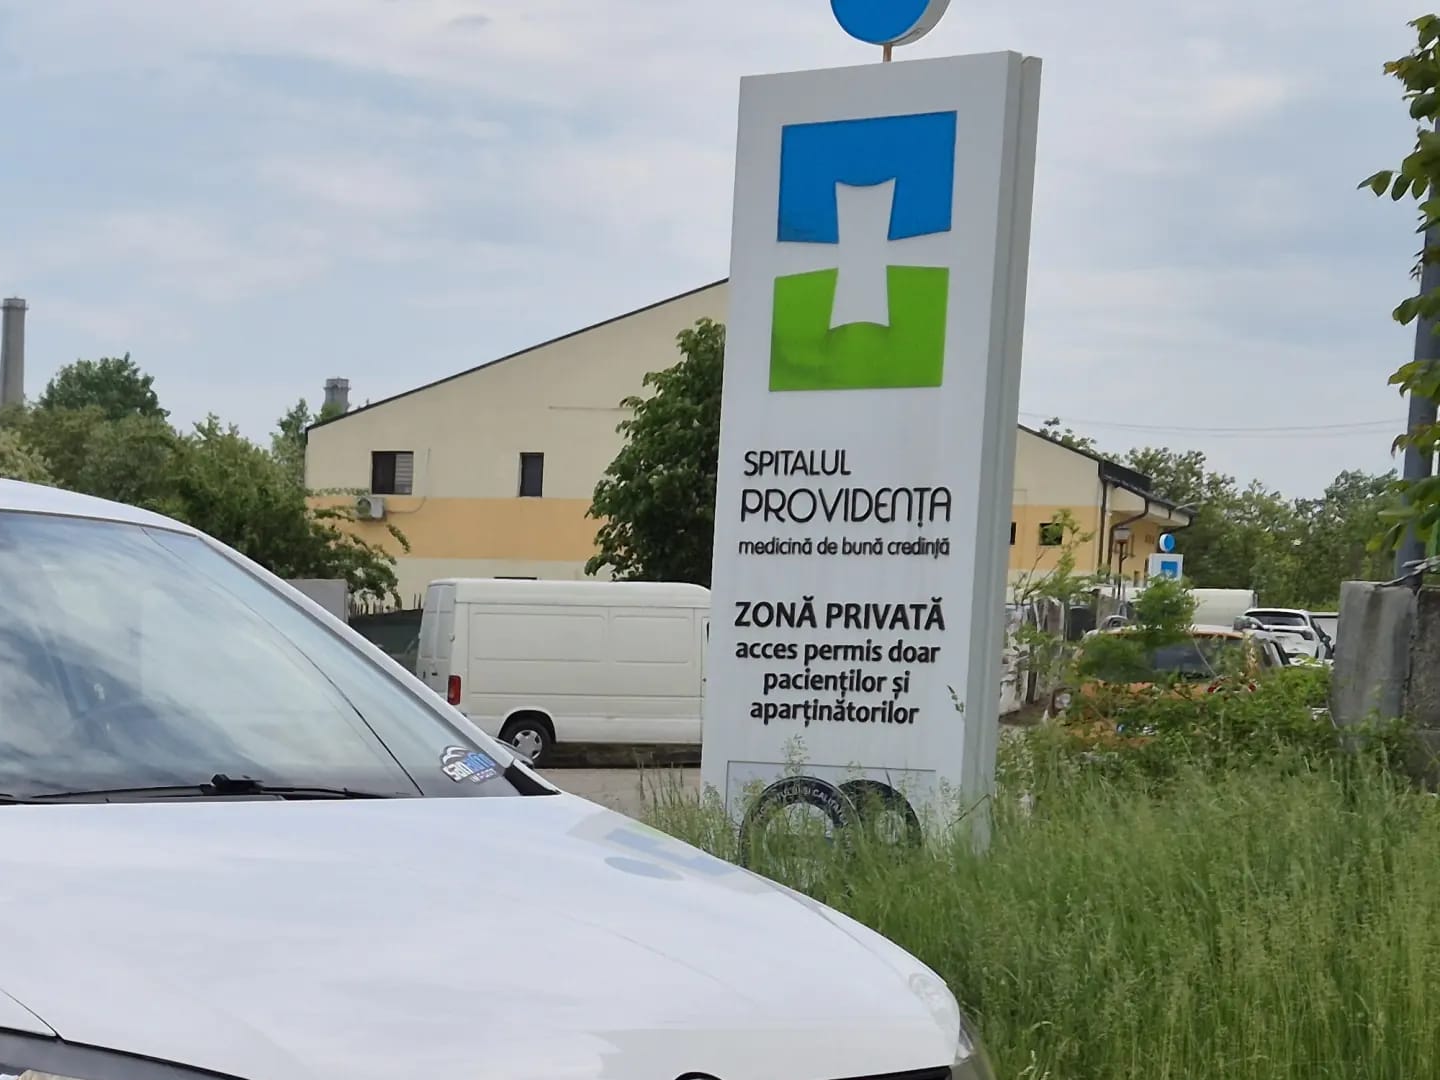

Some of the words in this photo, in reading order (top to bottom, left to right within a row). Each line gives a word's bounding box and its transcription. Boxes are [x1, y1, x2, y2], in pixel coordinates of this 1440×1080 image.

[743, 449, 852, 476] SPITALUL
[740, 486, 953, 527] PROVIDENȚA
[738, 536, 813, 555] medicină
[816, 536, 838, 555] de
[842, 536, 883, 556] bună
[887, 536, 950, 559] credință
[734, 595, 818, 629] ZONĂ
[825, 596, 946, 631] PRIVATĂ
[735, 641, 798, 660] acces
[803, 639, 883, 666] permis
[888, 639, 941, 664] doar
[763, 668, 888, 697] pacienților
[891, 670, 910, 700] și
